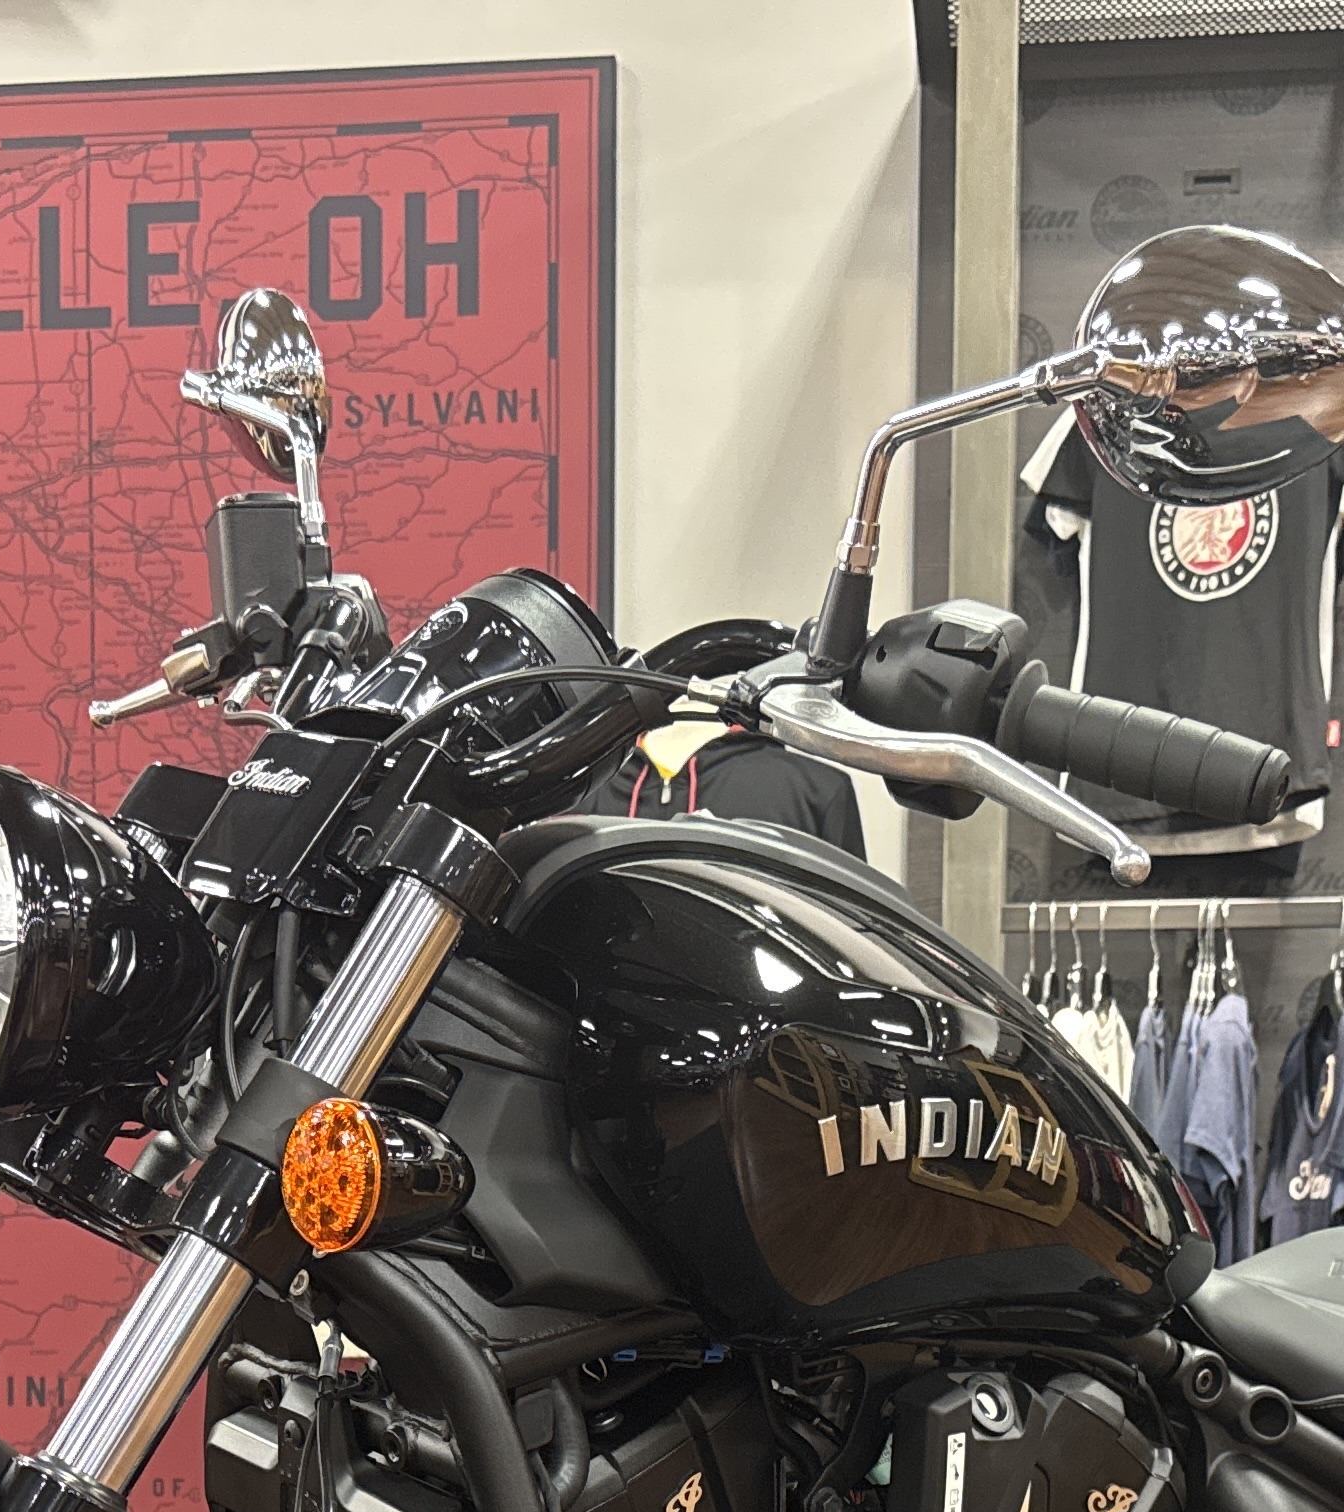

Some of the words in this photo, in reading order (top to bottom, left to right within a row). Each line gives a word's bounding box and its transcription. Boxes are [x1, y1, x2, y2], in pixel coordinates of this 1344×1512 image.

[308, 188, 480, 322] OH
[328, 389, 540, 430] SYLVANI
[818, 1097, 1067, 1186] INDIAN
[151, 1477, 185, 1498] OF
